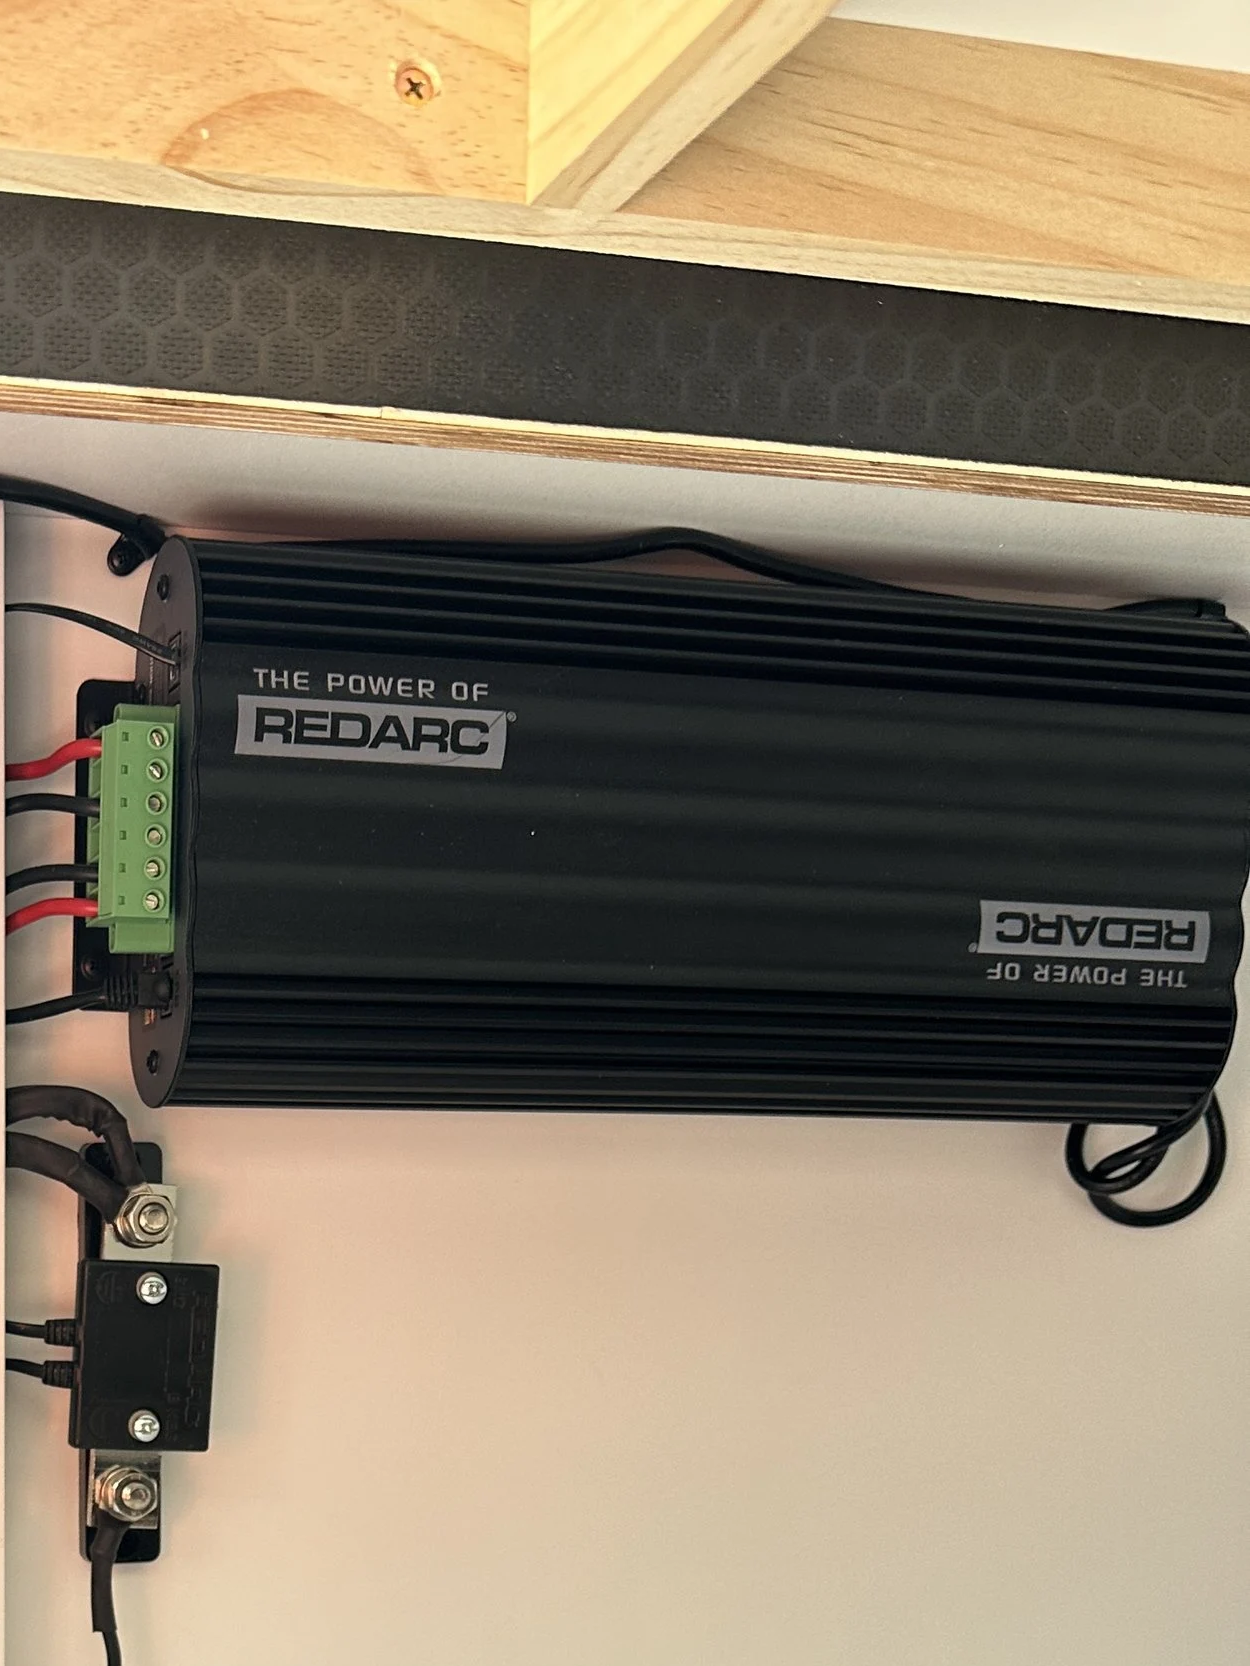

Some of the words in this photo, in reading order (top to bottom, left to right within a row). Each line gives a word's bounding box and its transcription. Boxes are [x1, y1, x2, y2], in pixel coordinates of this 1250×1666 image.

[253, 668, 310, 692] THE
[327, 672, 435, 699] POWER
[451, 681, 489, 702] OF
[253, 706, 490, 756] REDARC
[995, 911, 1197, 952] REDARC
[986, 962, 1021, 981] OF
[1033, 963, 1127, 986] POWER
[1140, 968, 1188, 988] THE
